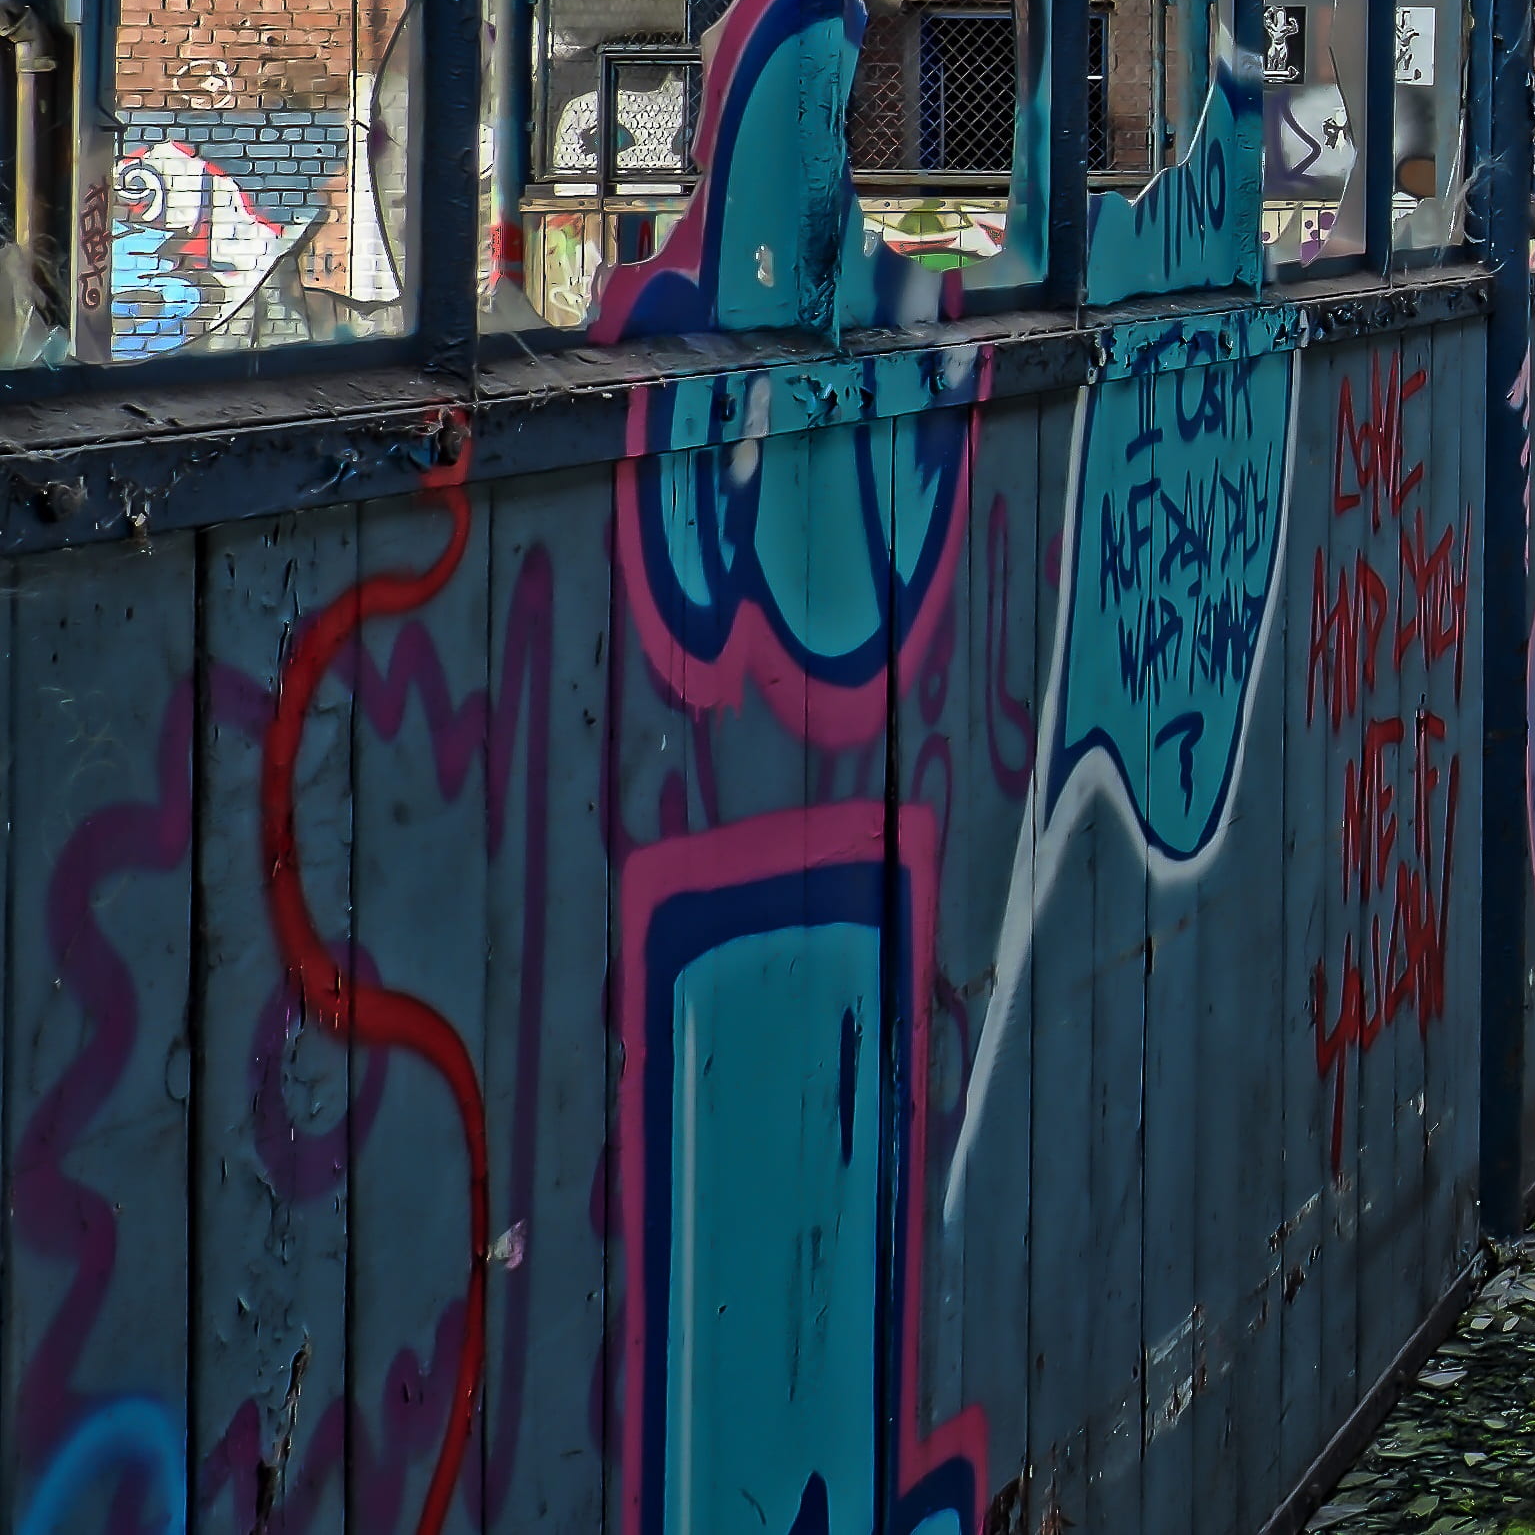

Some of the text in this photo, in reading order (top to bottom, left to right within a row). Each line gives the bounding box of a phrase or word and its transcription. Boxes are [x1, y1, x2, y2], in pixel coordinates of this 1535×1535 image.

[1307, 543, 1389, 736] AND
[1342, 707, 1447, 905] ME IF
